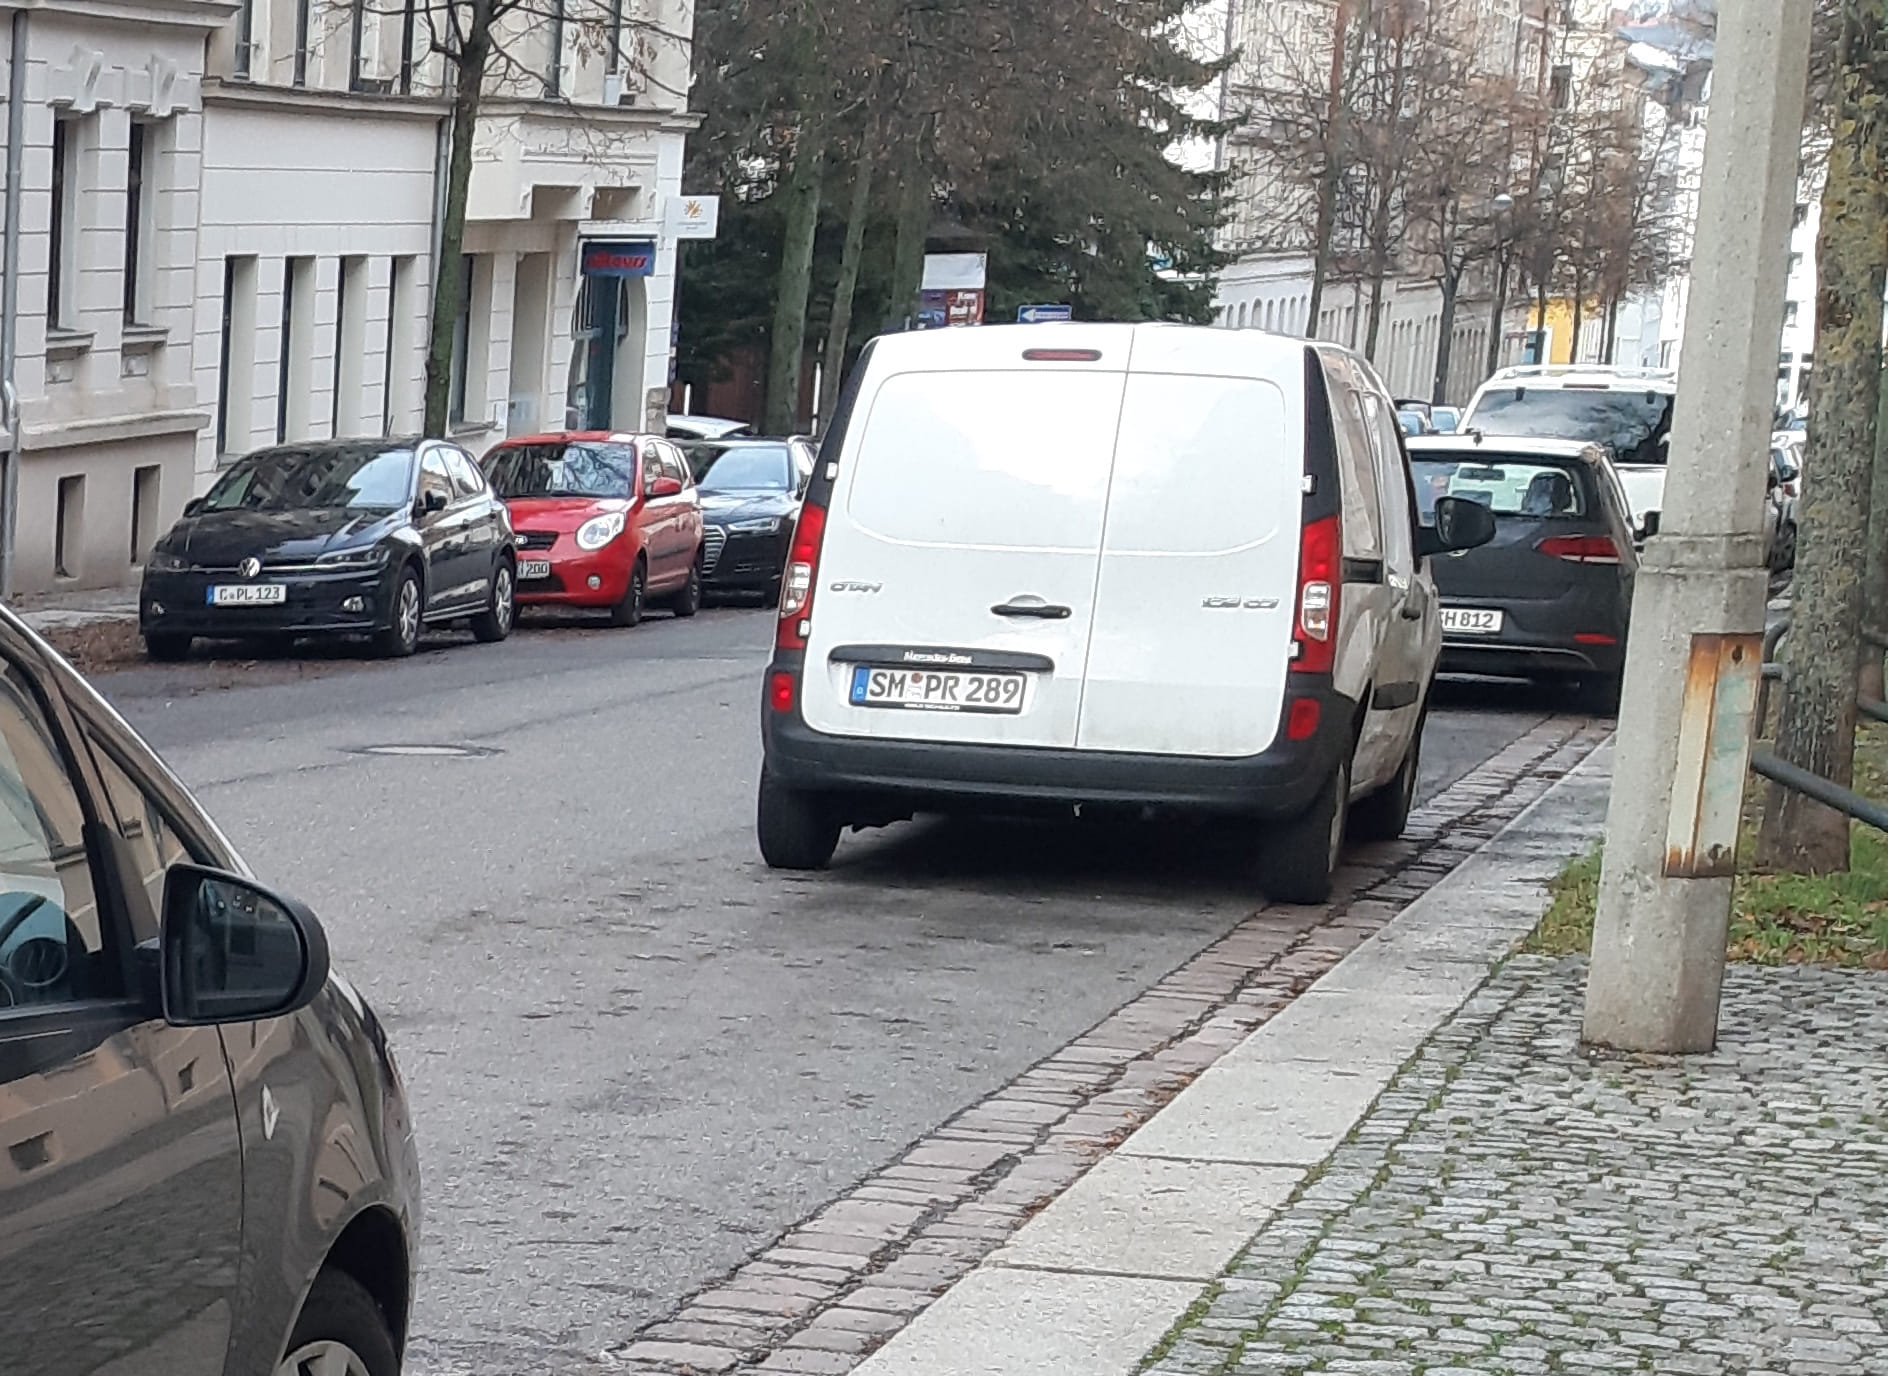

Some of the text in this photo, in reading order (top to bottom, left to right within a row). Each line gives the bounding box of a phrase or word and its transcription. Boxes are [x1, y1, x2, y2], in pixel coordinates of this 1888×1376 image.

[255, 587, 280, 600] 123
[1460, 611, 1494, 628] 812
[869, 672, 907, 698] SM
[924, 674, 960, 702] PR
[965, 677, 1020, 704] 289
